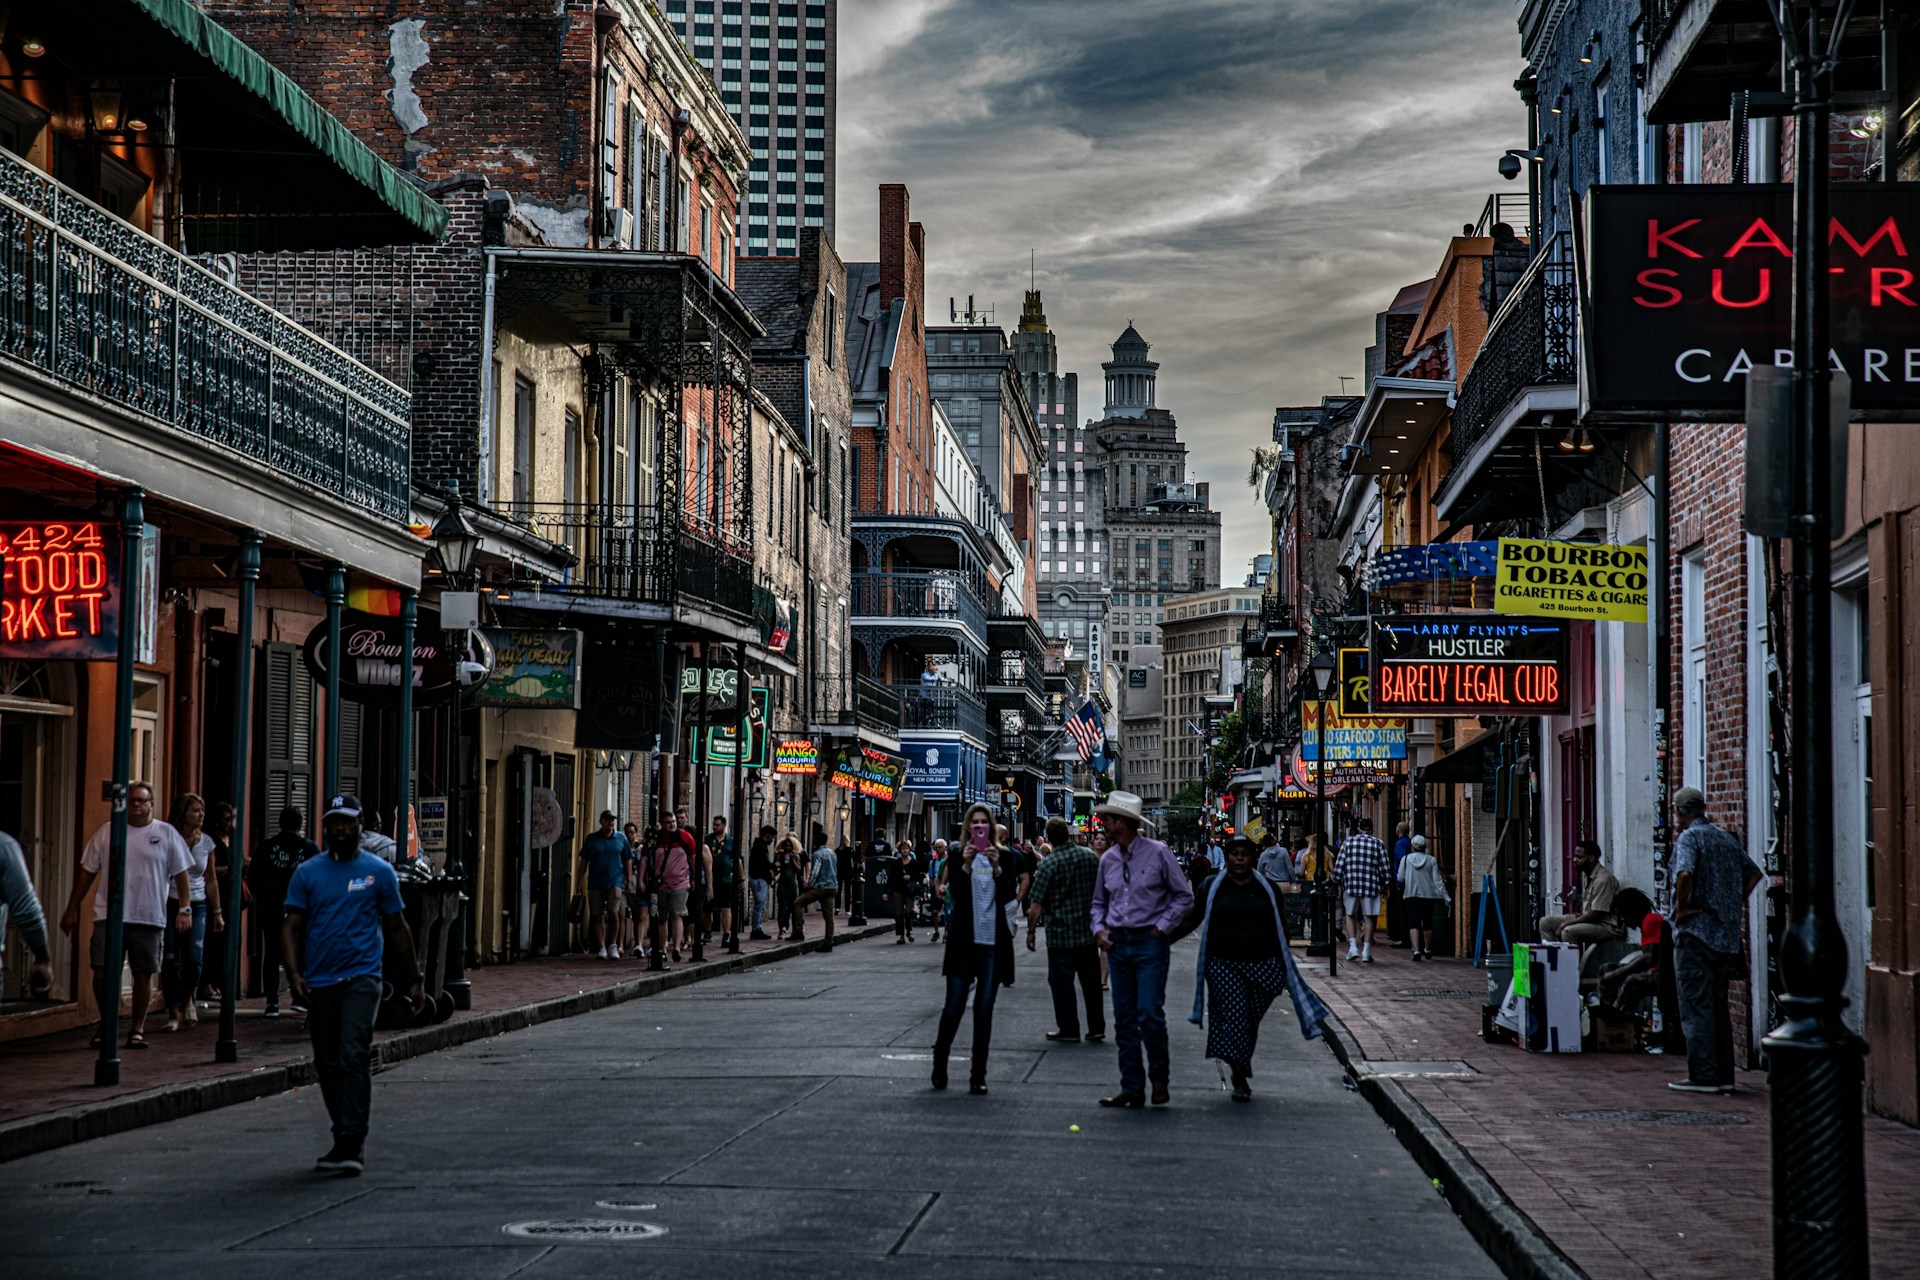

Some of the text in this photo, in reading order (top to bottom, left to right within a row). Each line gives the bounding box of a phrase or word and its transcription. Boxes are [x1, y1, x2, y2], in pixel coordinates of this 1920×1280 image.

[1632, 267, 1919, 309] SUR
[12, 523, 102, 551] 424
[1503, 543, 1648, 569] BOURBON
[1505, 564, 1648, 590] TOBACCO
[1500, 585, 1648, 606] CIGARETTES & CIGARS
[1539, 602, 1609, 614] 425 Bourbon St.
[1412, 624, 1530, 637] LARRY FLYNT'S
[347, 629, 437, 659] Bouron
[1428, 639, 1505, 657] HUSTLER
[1131, 671, 1145, 679] AC
[1380, 664, 1449, 703] BARELY
[1455, 664, 1510, 704] LEGAL
[1514, 665, 1559, 703] CLUB
[782, 740, 812, 748] MANGO
[1336, 729, 1375, 744] SEAFOOD
[1377, 729, 1405, 744] STEAKS
[776, 747, 818, 758] MANGO
[1324, 744, 1352, 760] YSTERS
[1335, 767, 1375, 776] AUTHENTIC
[1361, 760, 1388, 769] SHACK
[1332, 775, 1366, 784] ORLEANS
[1366, 775, 1395, 784] CUISINE
